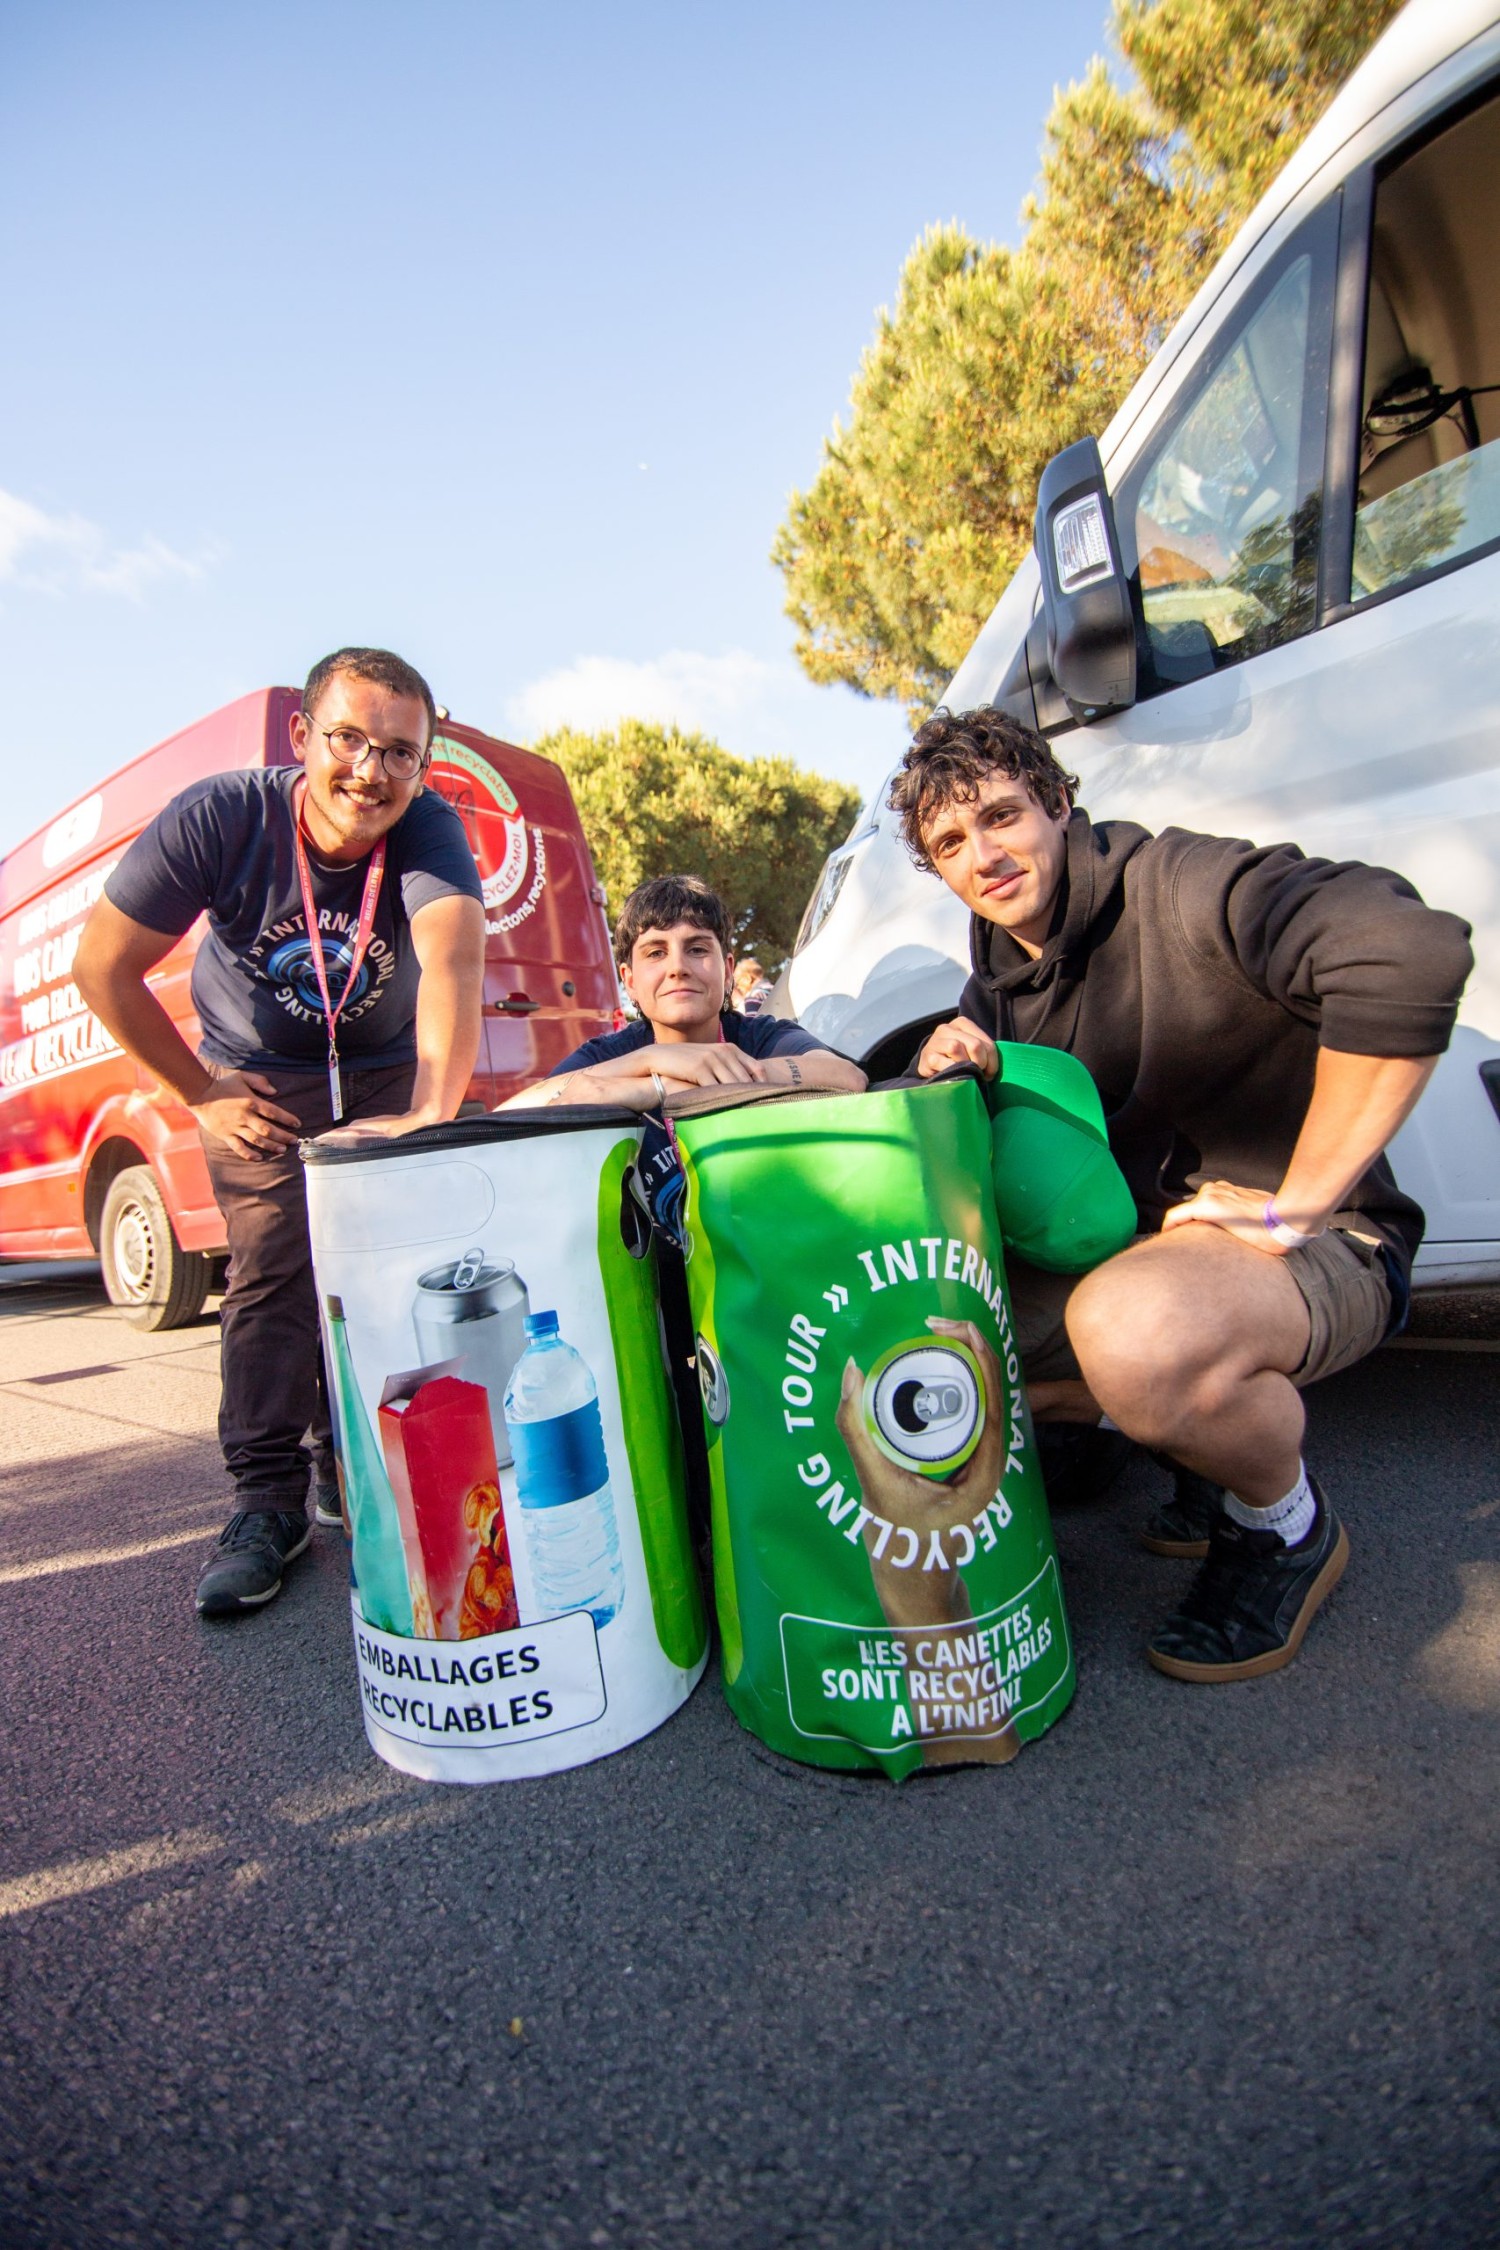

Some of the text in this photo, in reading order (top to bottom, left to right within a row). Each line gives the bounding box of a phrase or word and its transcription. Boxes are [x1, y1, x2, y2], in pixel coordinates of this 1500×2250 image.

[449, 746, 512, 807] recyclable
[482, 832, 523, 901] CYCLEZ-MOI
[527, 827, 547, 906] recyclons
[274, 985, 384, 1026] RECYLING
[781, 1237, 1025, 1571] INTERNATIONAL RECYCLING TOUR
[358, 1632, 541, 1686] EMBALLAGES
[821, 1617, 1052, 1701] SONT RECYCLABLES
[859, 1603, 1032, 1668] LES CANETTES
[362, 1675, 554, 1733] RECYCLABLES
[891, 1676, 1023, 1738] A L'INFINI
